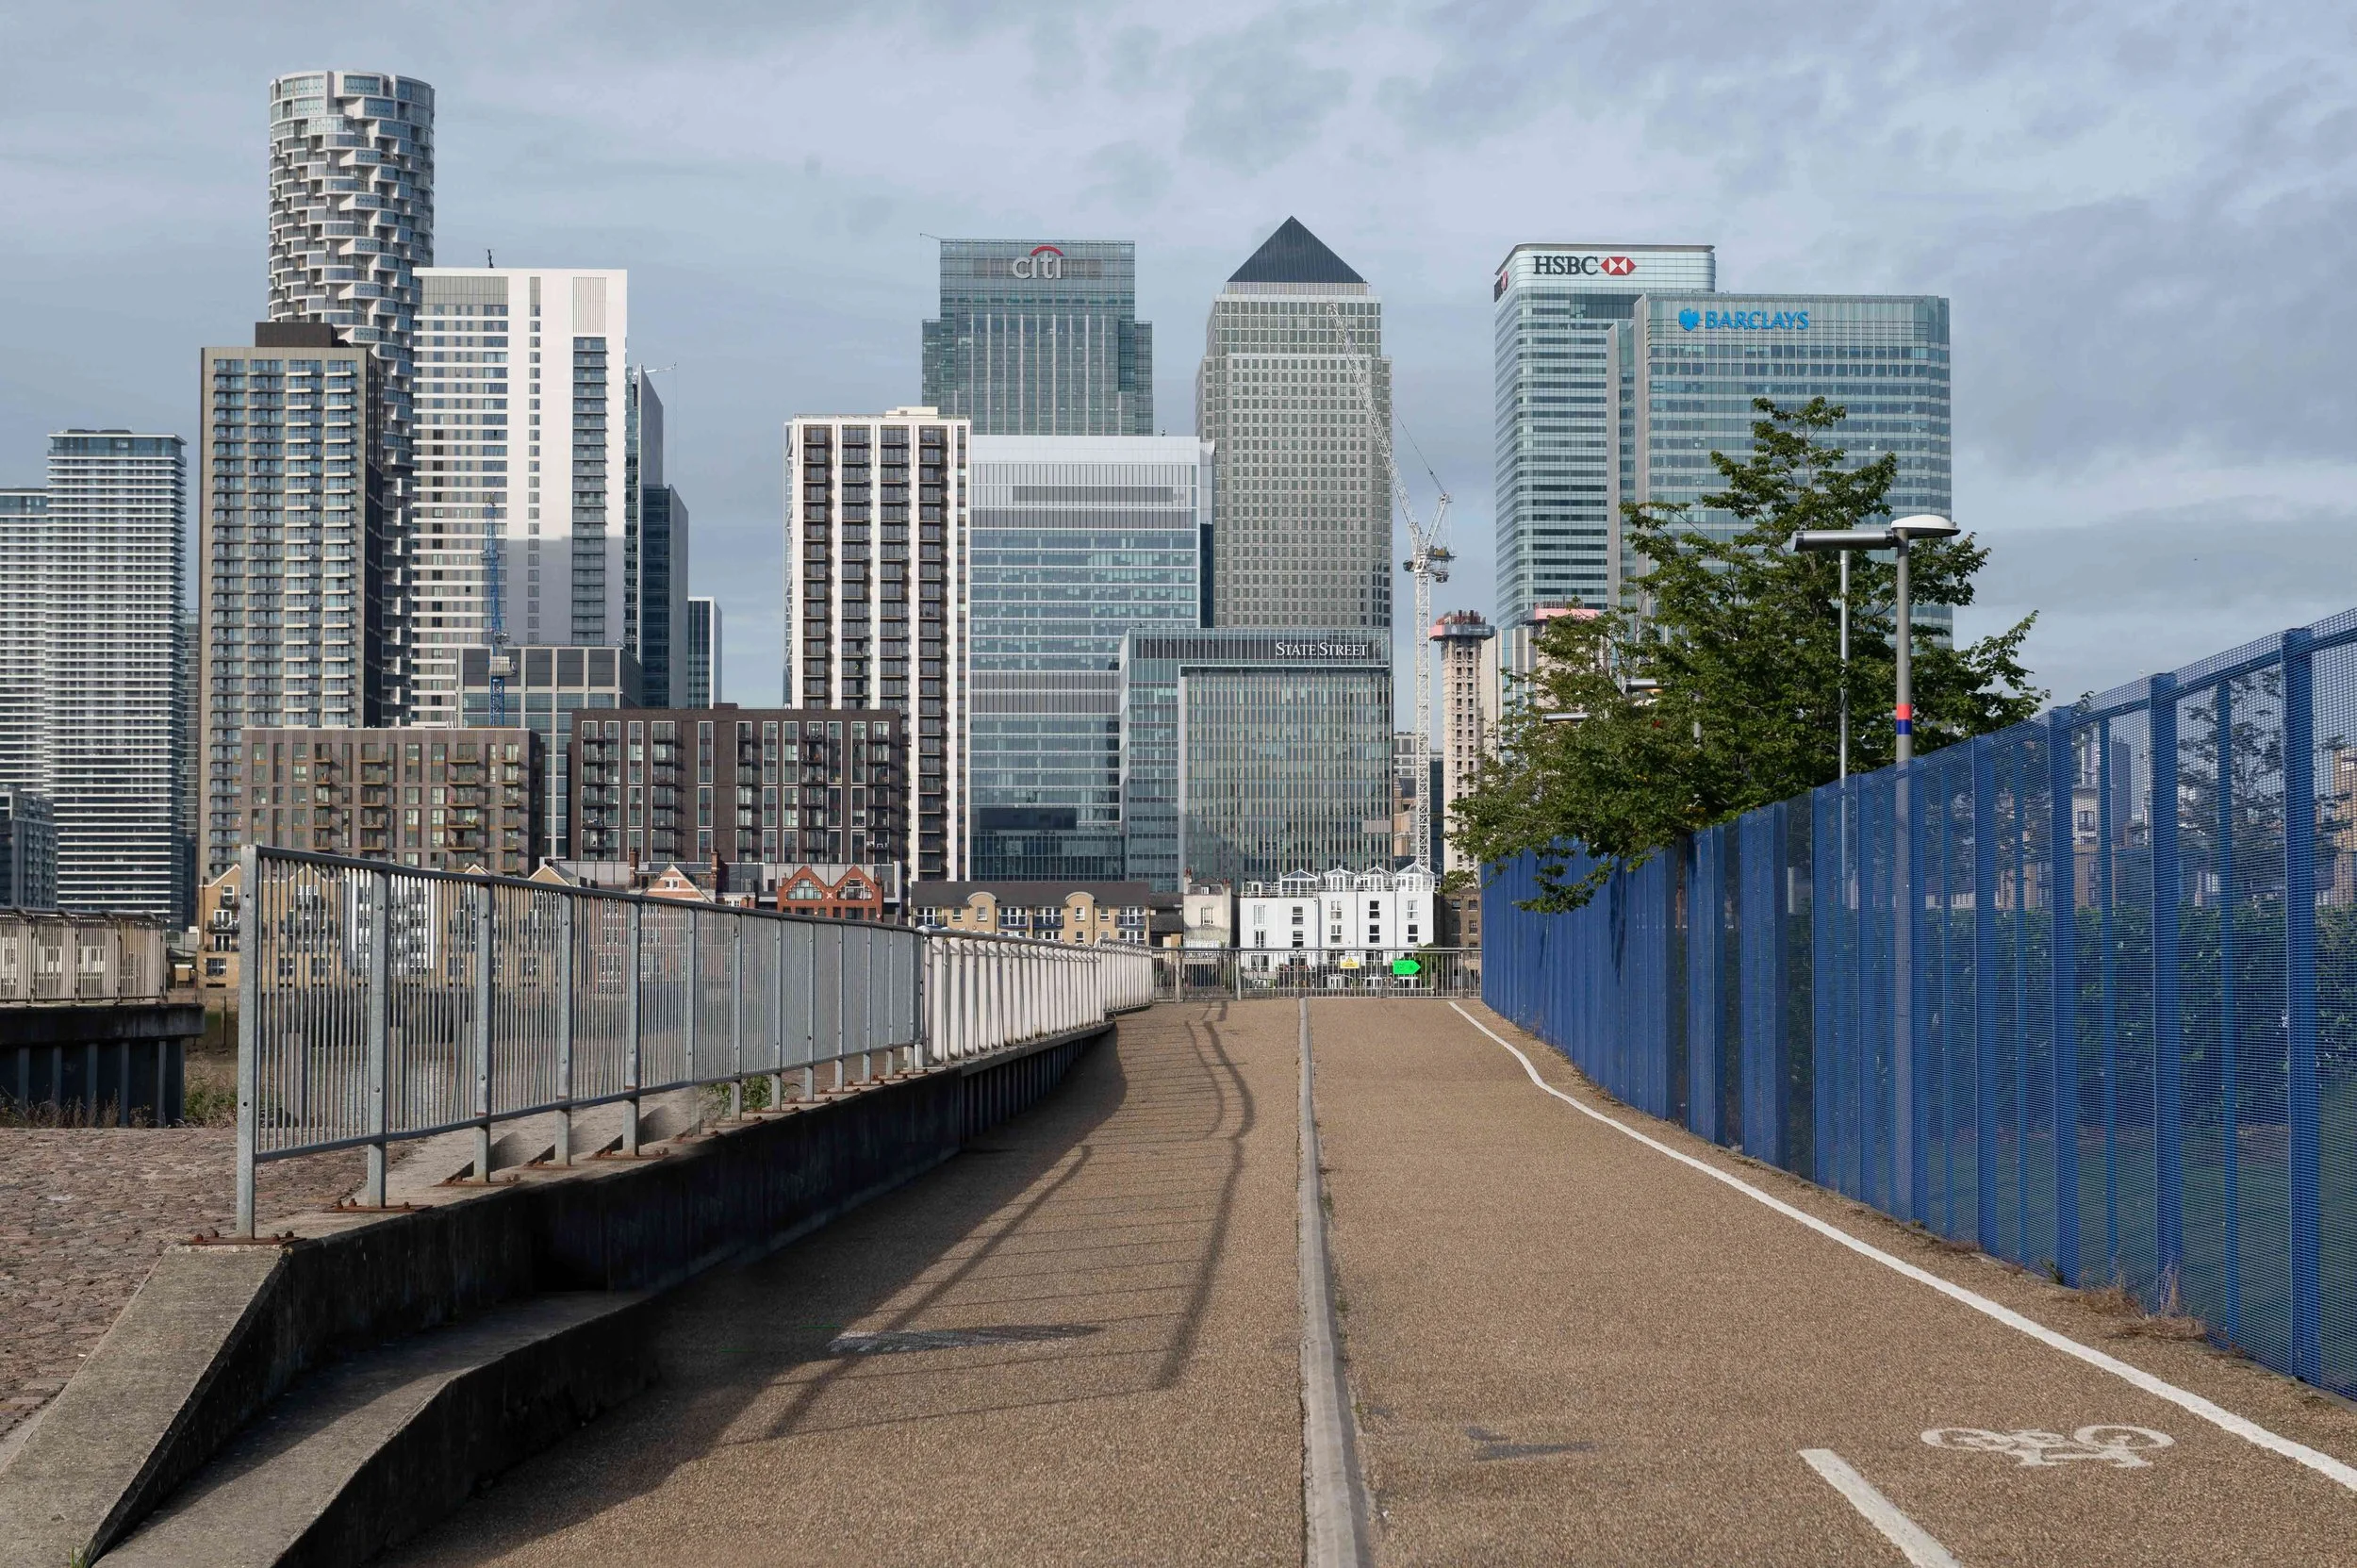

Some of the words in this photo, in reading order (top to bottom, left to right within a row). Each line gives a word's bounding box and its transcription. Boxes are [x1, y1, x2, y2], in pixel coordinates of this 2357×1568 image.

[1012, 249, 1062, 279] citi
[1533, 256, 1599, 275] HSBC
[1705, 310, 1809, 330] BARCLAYS
[1276, 642, 1316, 656] STATE
[1319, 642, 1368, 656] STREET
